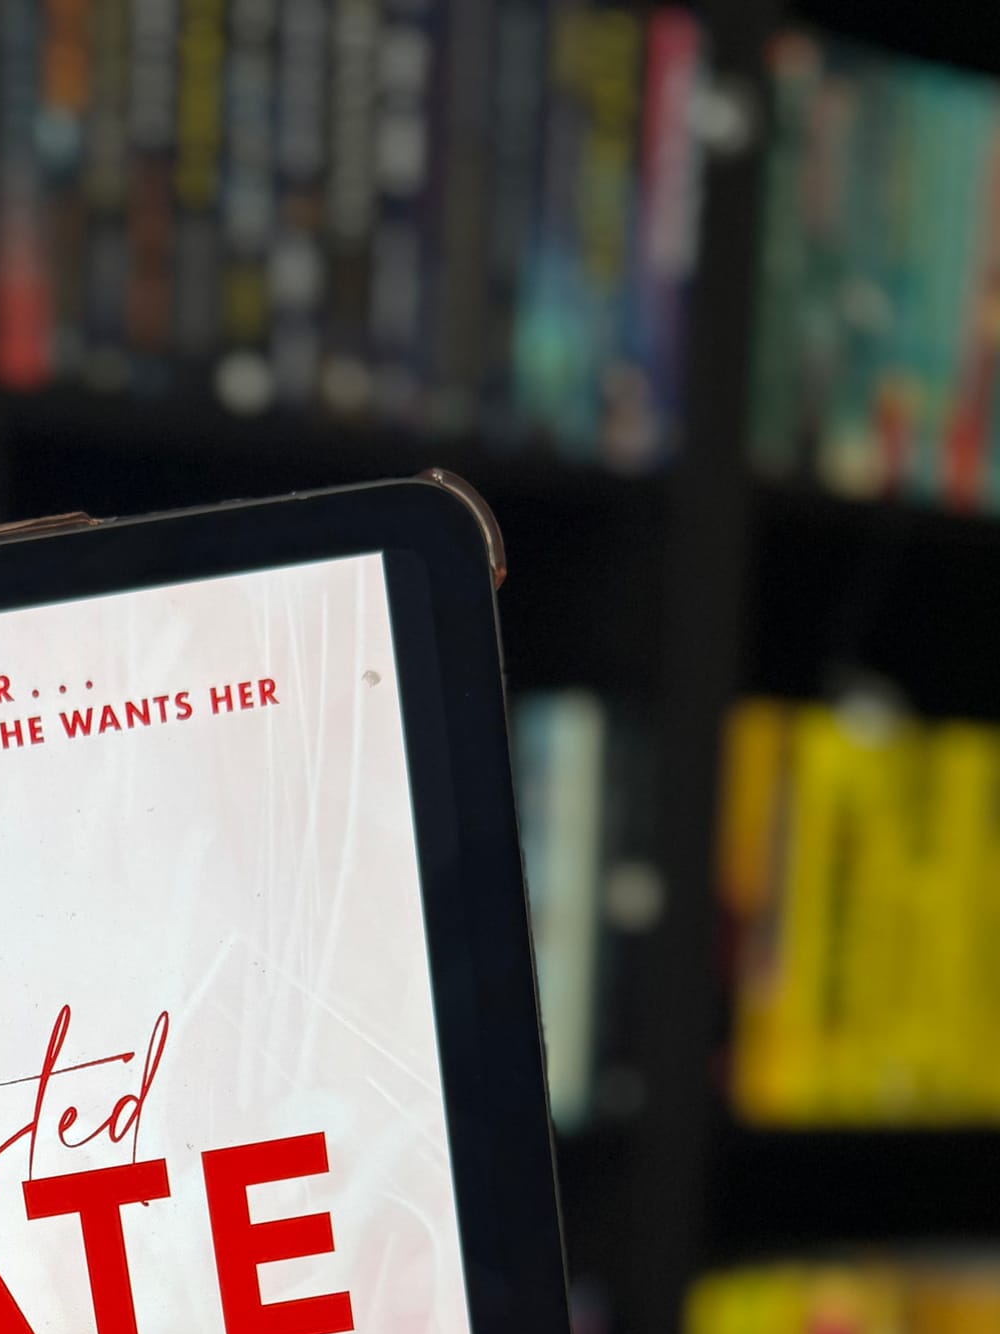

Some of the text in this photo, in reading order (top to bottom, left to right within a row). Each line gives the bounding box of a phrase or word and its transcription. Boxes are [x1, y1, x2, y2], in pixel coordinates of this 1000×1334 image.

[0, 717, 44, 749] HE
[60, 692, 194, 738] WANTS
[210, 678, 278, 714] HER
